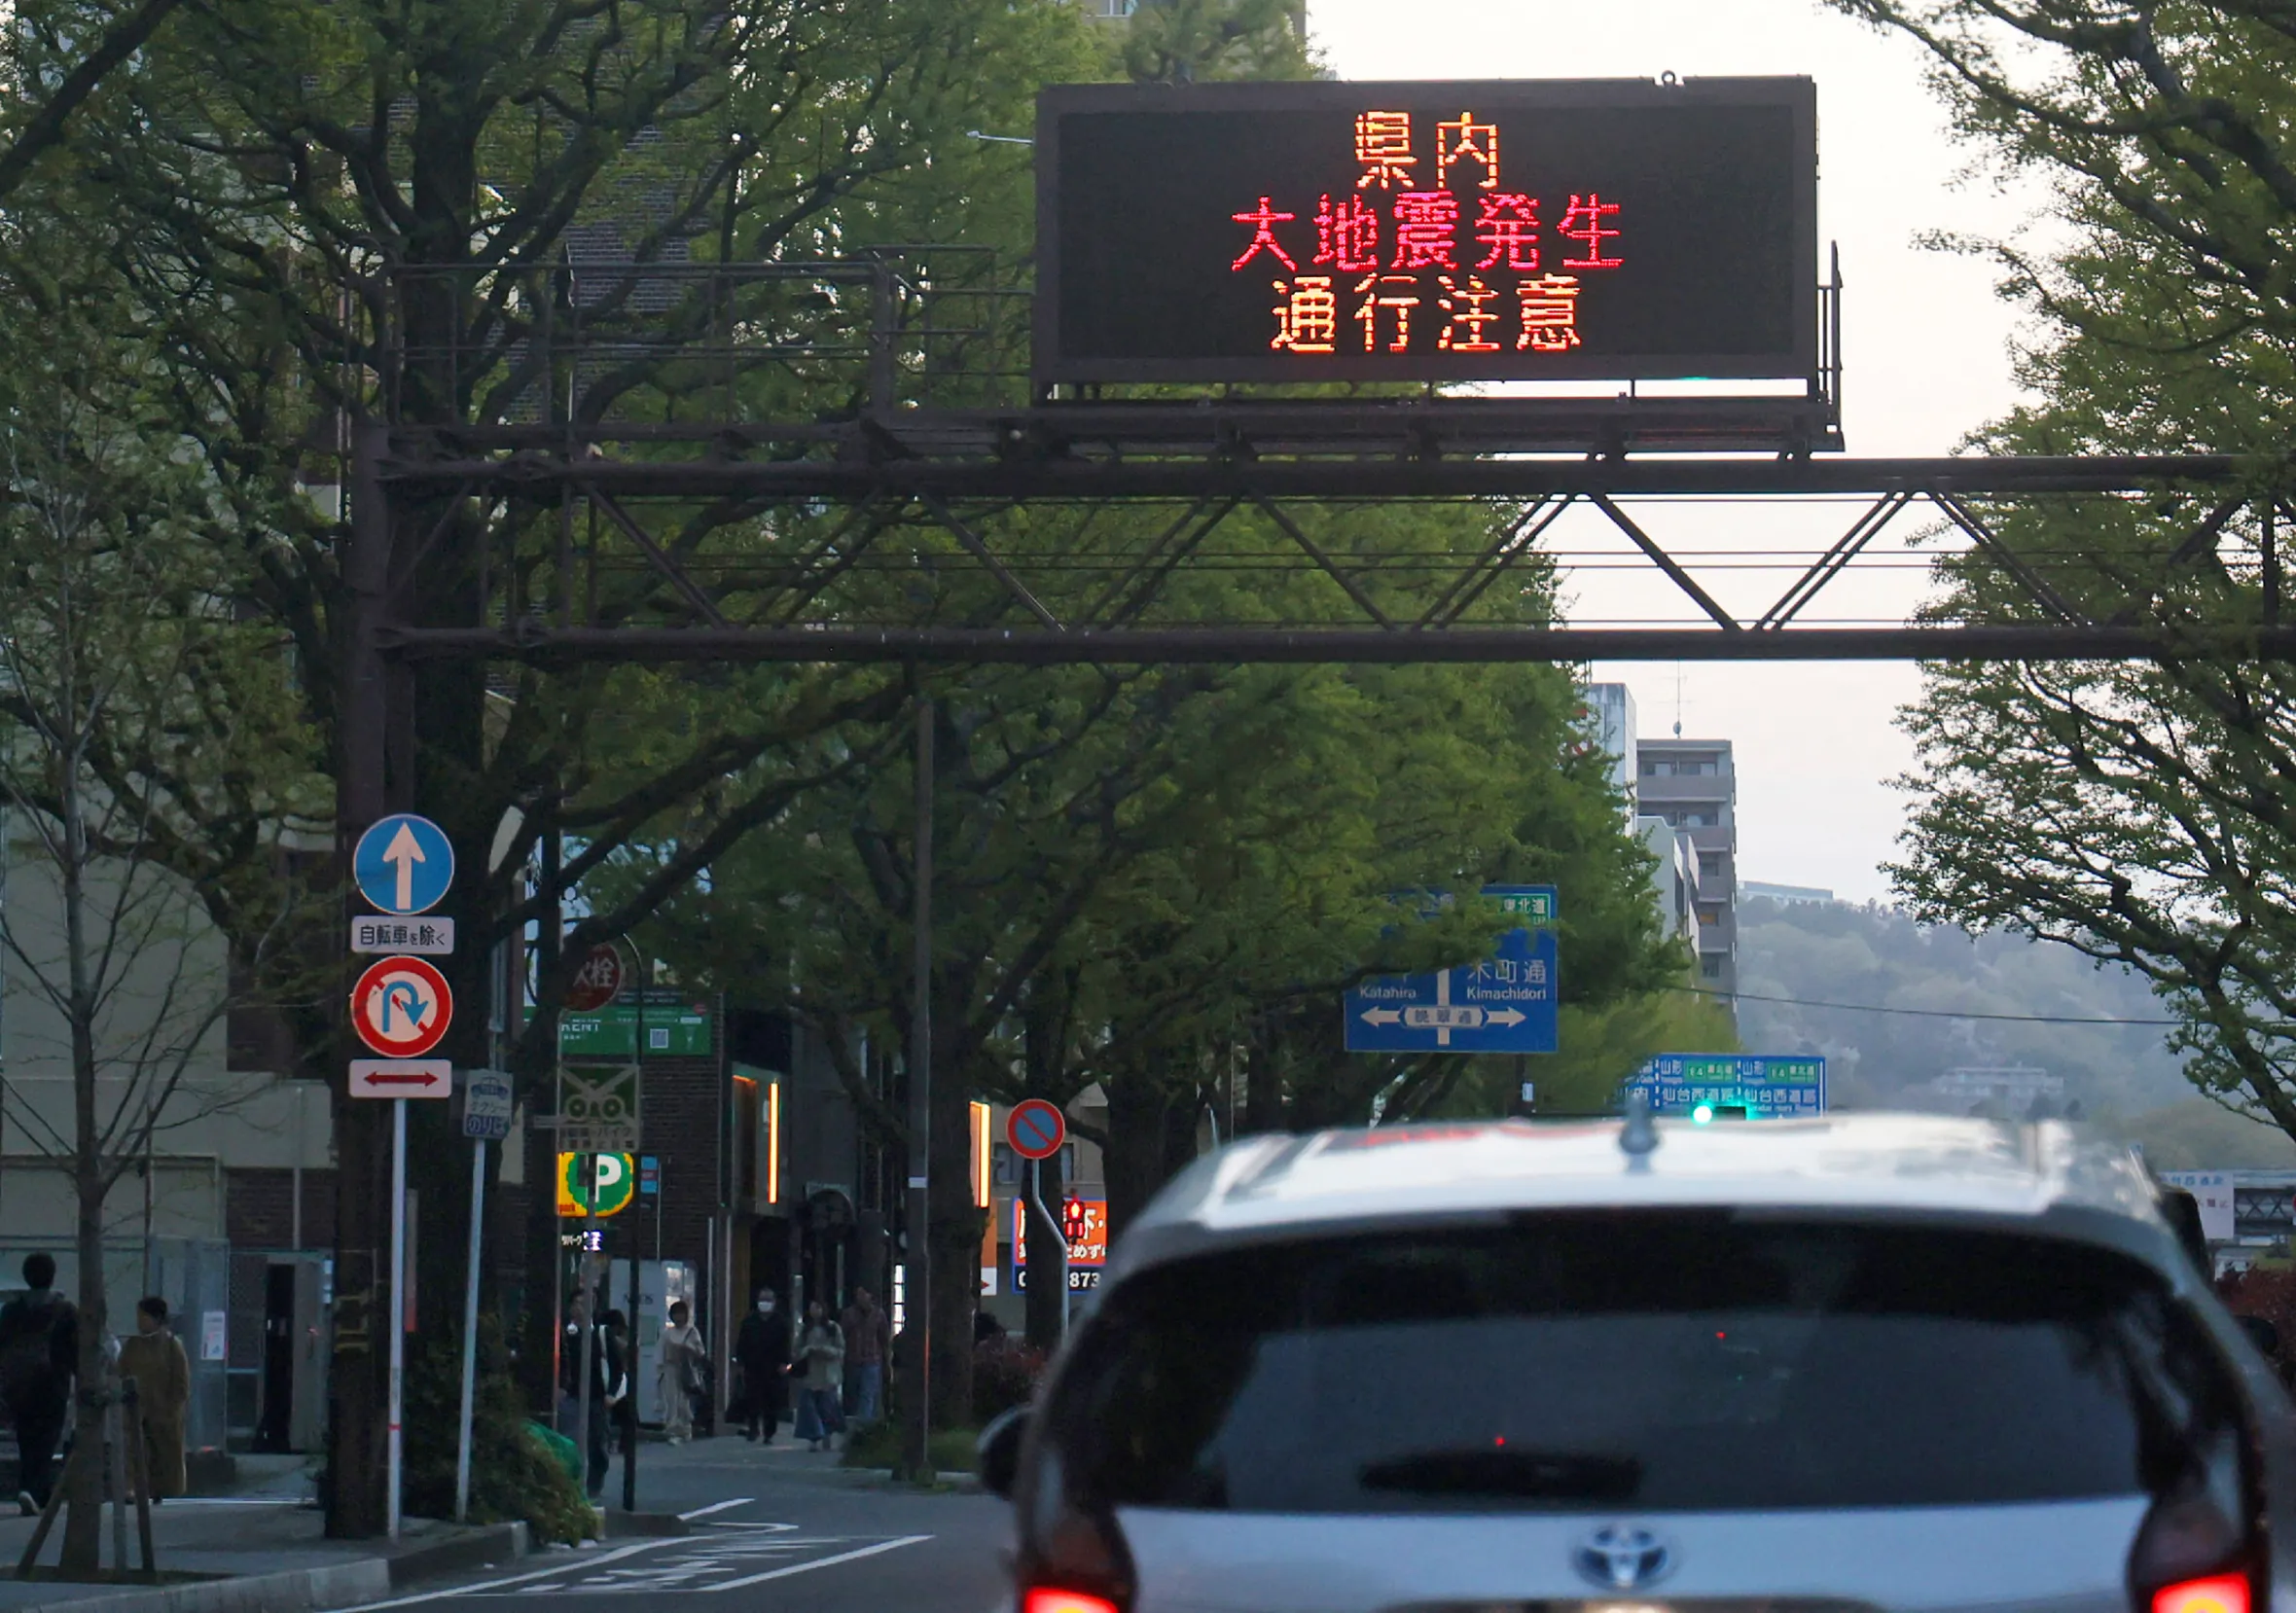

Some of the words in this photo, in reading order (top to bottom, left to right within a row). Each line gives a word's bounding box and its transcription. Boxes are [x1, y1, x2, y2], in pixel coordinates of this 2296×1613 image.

[1354, 110, 1499, 190] 県内
[1231, 191, 1625, 272] 大地震発生
[1270, 272, 1582, 352] 通行注意
[1503, 898, 1546, 914] 東北道
[360, 925, 447, 946] 自転車を除く
[572, 957, 615, 987] 火栓
[1467, 959, 1547, 984] 木町通
[1360, 986, 1417, 999] Katahira
[1467, 986, 1547, 1000] Kimachidori
[586, 1155, 622, 1203] P
